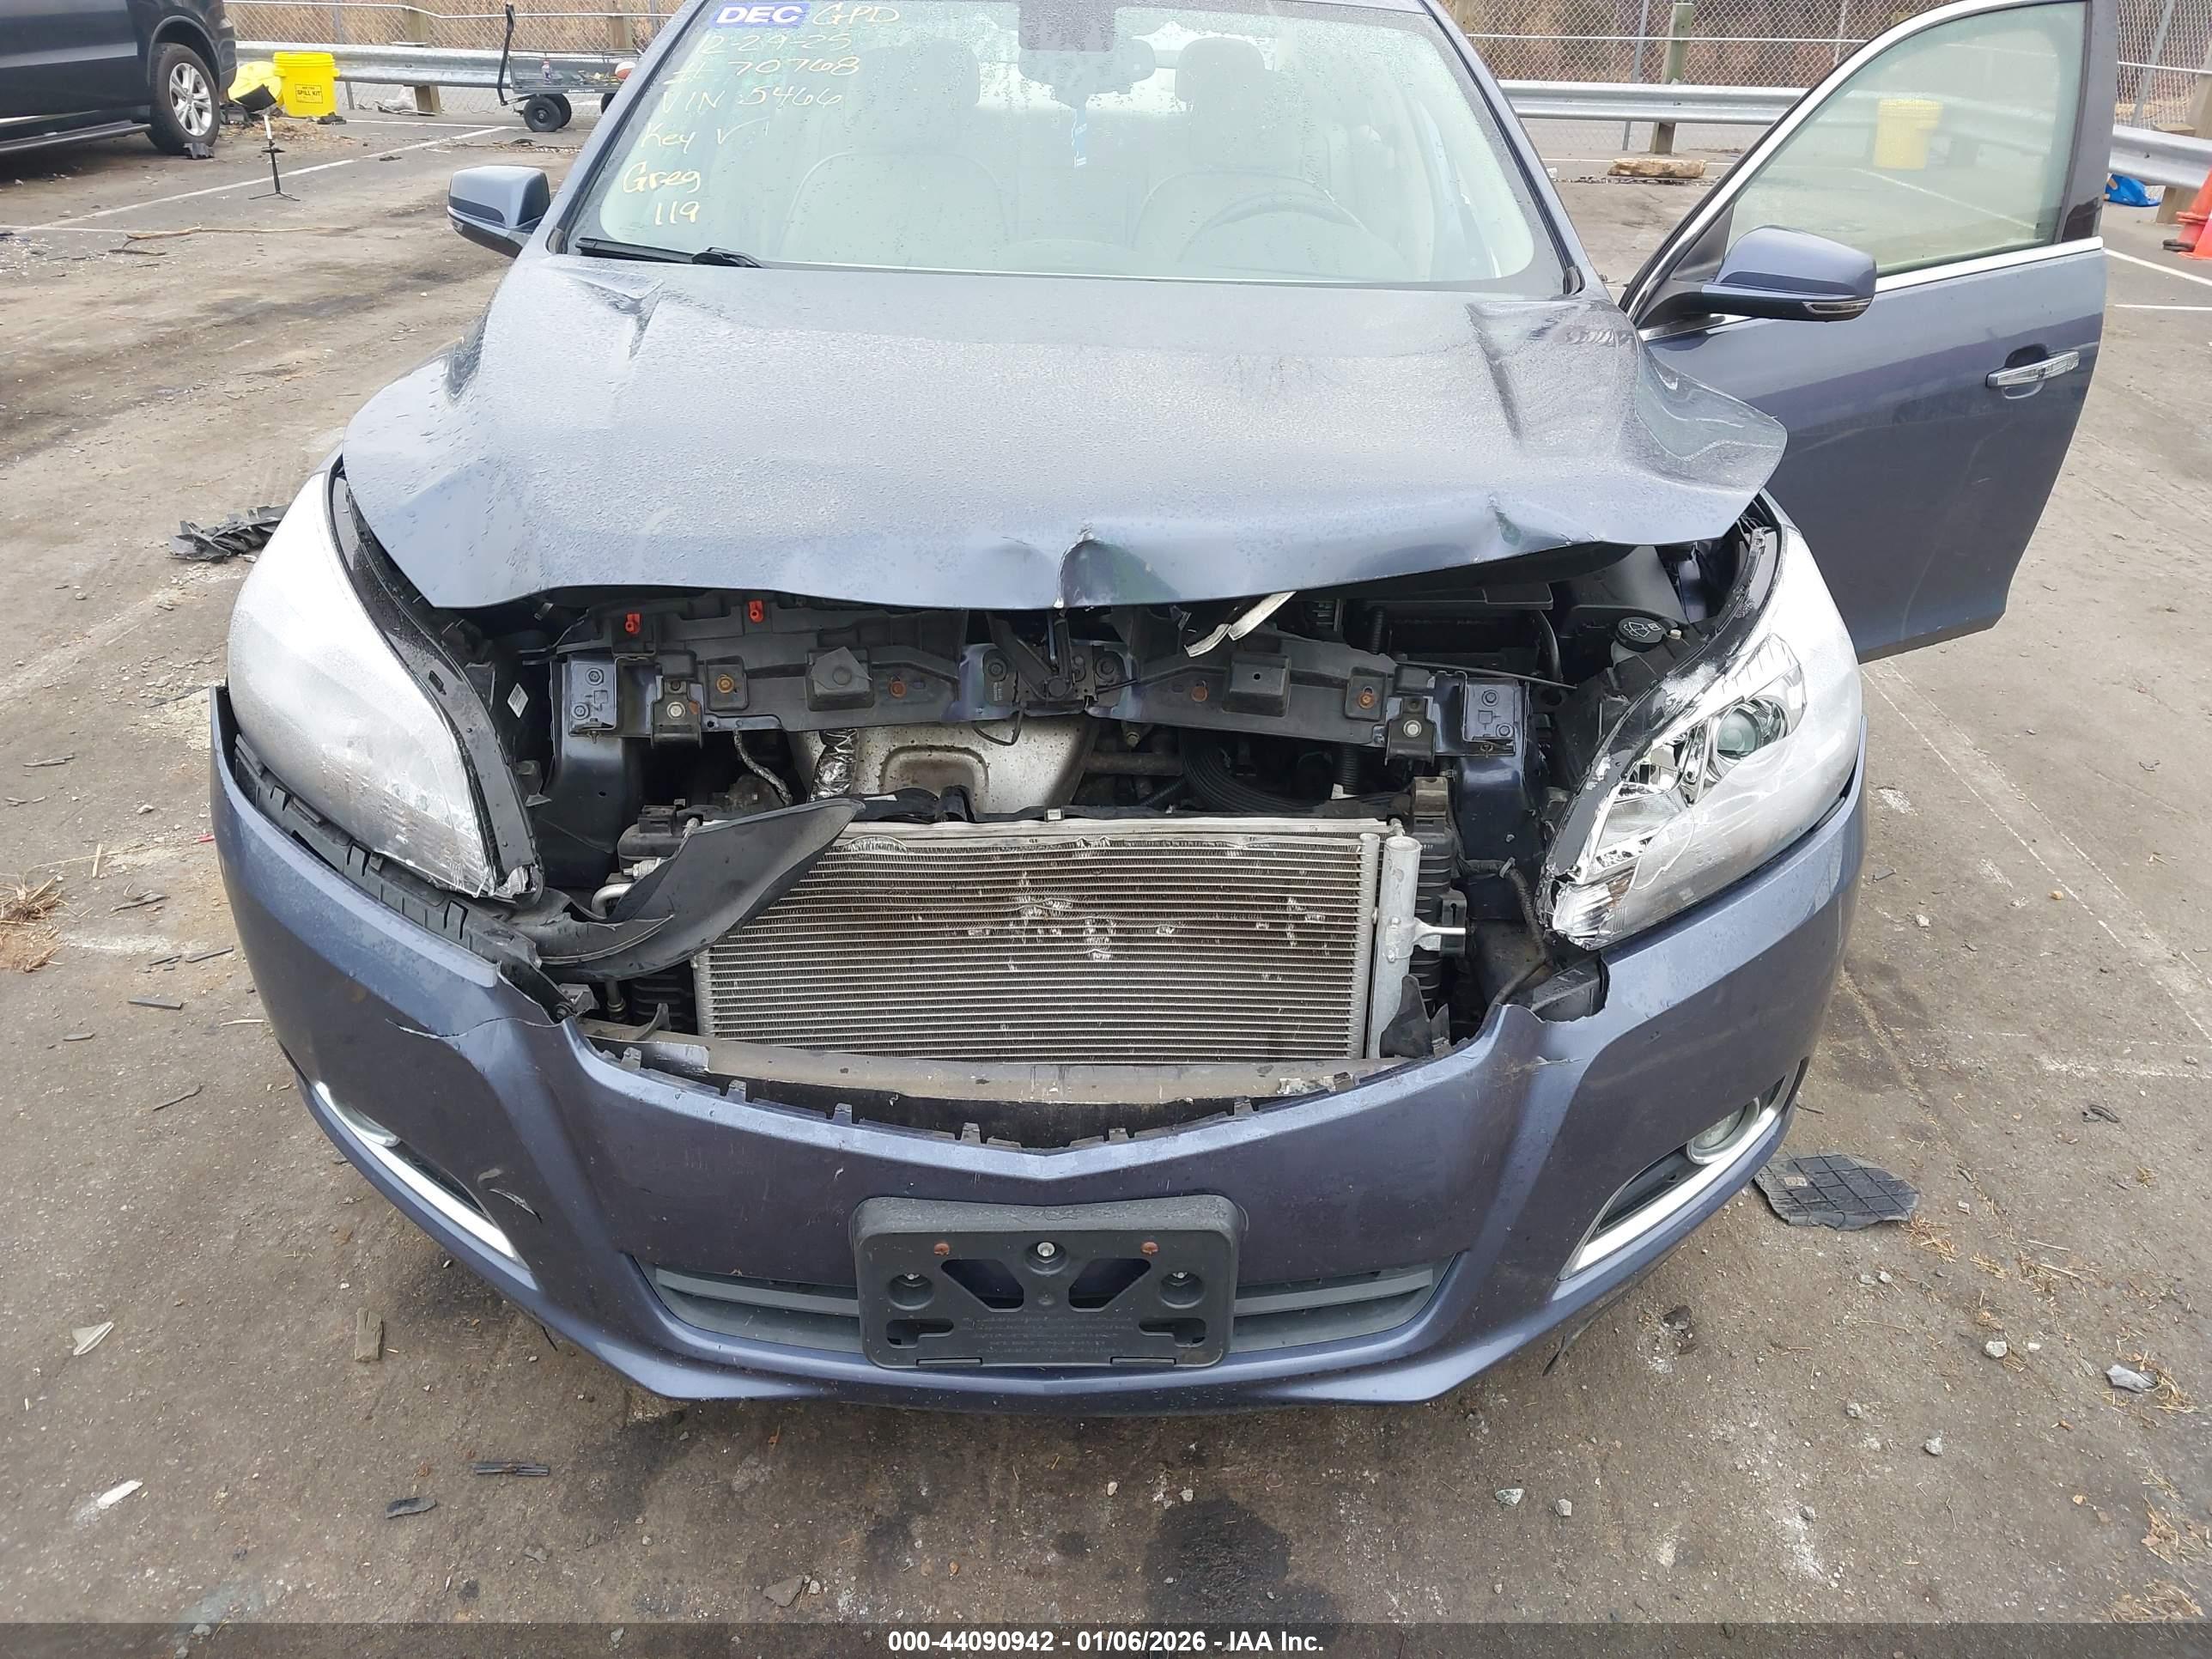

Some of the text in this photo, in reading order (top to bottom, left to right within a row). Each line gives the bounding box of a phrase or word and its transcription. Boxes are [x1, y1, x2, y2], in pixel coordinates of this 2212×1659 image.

[715, 5, 805, 23] DEC
[812, 3, 901, 25] GPD
[728, 57, 860, 76] 70768
[662, 85, 842, 113] VIN 5466
[641, 122, 696, 154] Key
[623, 161, 701, 194] Greg
[654, 201, 700, 226] 119
